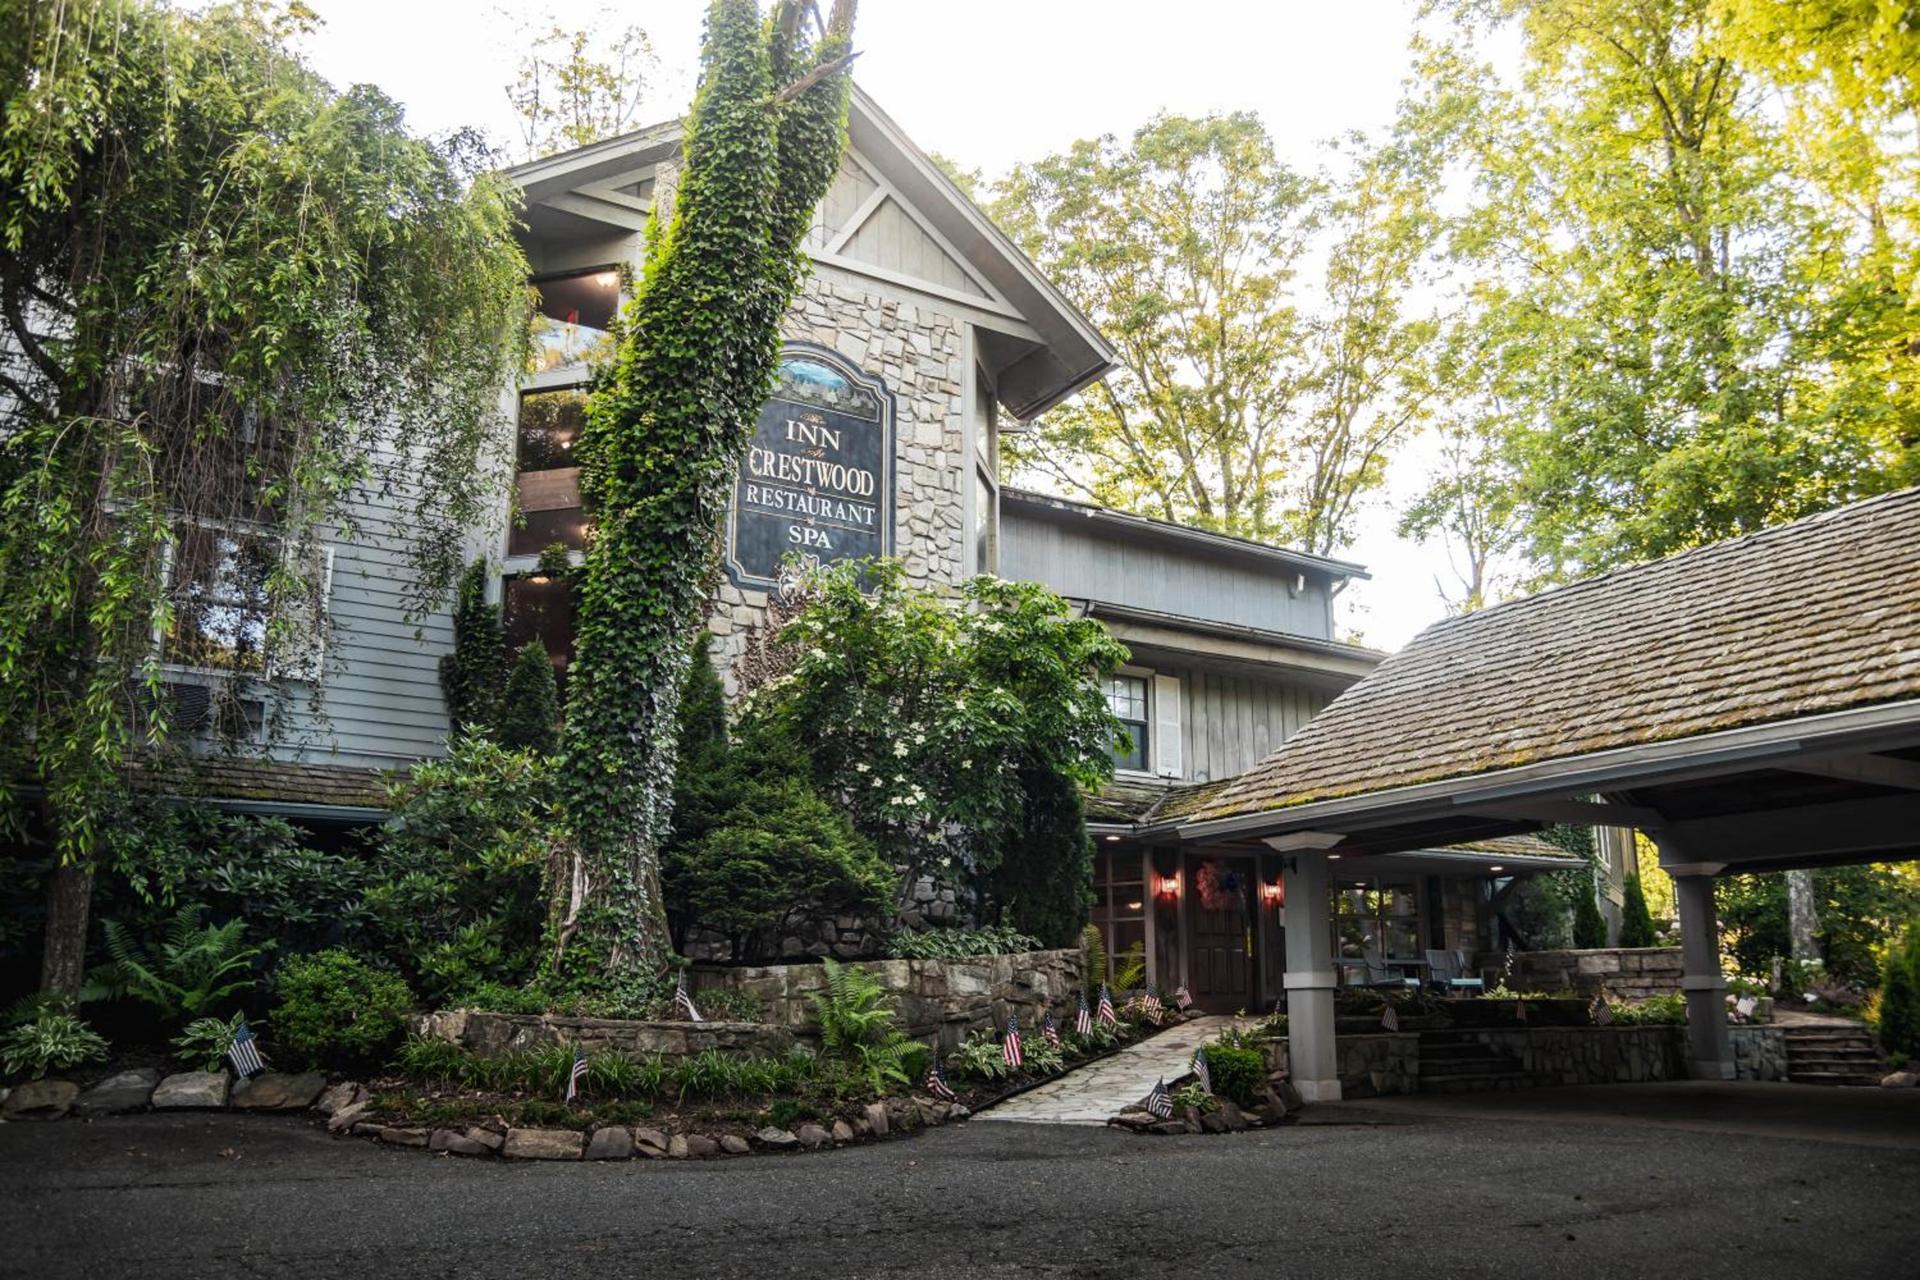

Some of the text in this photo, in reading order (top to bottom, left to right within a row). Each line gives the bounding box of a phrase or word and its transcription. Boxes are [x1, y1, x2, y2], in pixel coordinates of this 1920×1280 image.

[786, 419, 840, 450] INN
[749, 448, 874, 497] CRESTWOOD
[746, 484, 876, 525] RESTAURANT
[788, 525, 833, 549] SPA
